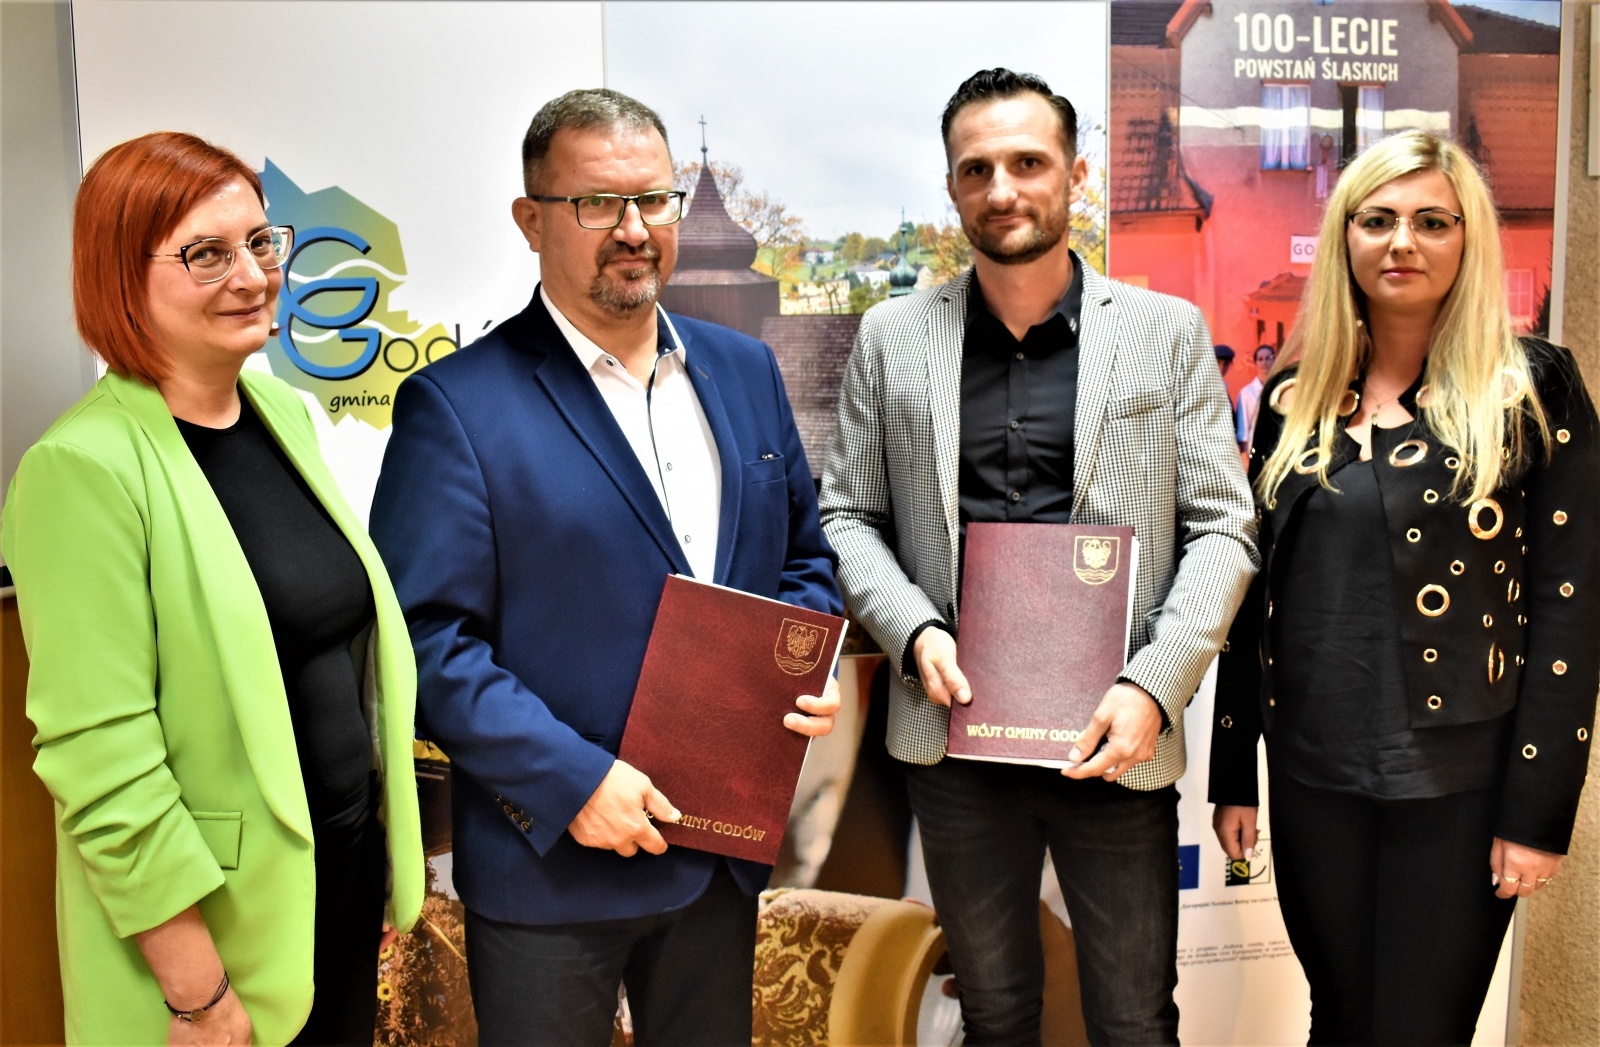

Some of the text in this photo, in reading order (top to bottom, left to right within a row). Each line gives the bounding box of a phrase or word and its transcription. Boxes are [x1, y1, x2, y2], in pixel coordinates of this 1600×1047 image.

[1234, 12, 1399, 56] 100-LECIE
[1234, 56, 1315, 79] POWSTAŃ
[1293, 243, 1315, 256] GO
[329, 390, 391, 413] gmina
[966, 722, 1087, 743] WÓJT GMINY GOD
[712, 821, 766, 842] GODÓW
